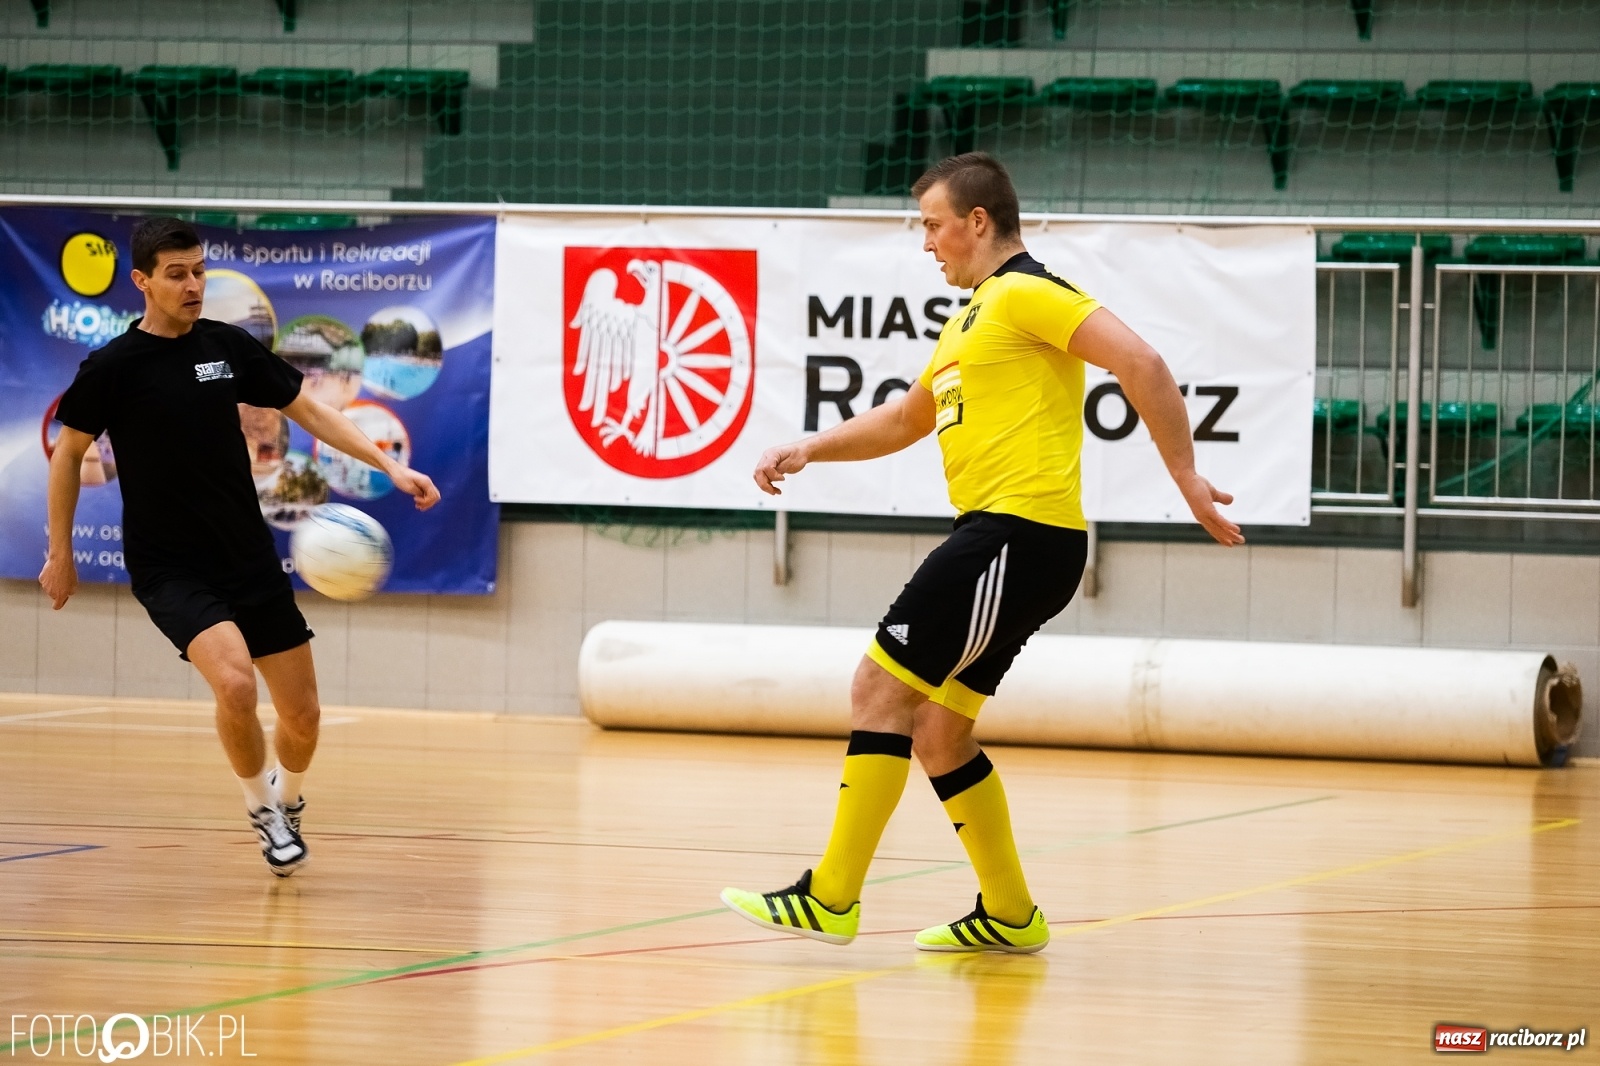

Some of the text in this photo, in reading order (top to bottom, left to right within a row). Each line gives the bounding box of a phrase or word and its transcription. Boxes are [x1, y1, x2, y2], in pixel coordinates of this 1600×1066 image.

[242, 243, 314, 267] Sportu
[319, 242, 326, 264] i
[332, 240, 432, 266] Rekreacji
[293, 269, 433, 292] w Raciborzu
[808, 296, 972, 341] MIAS
